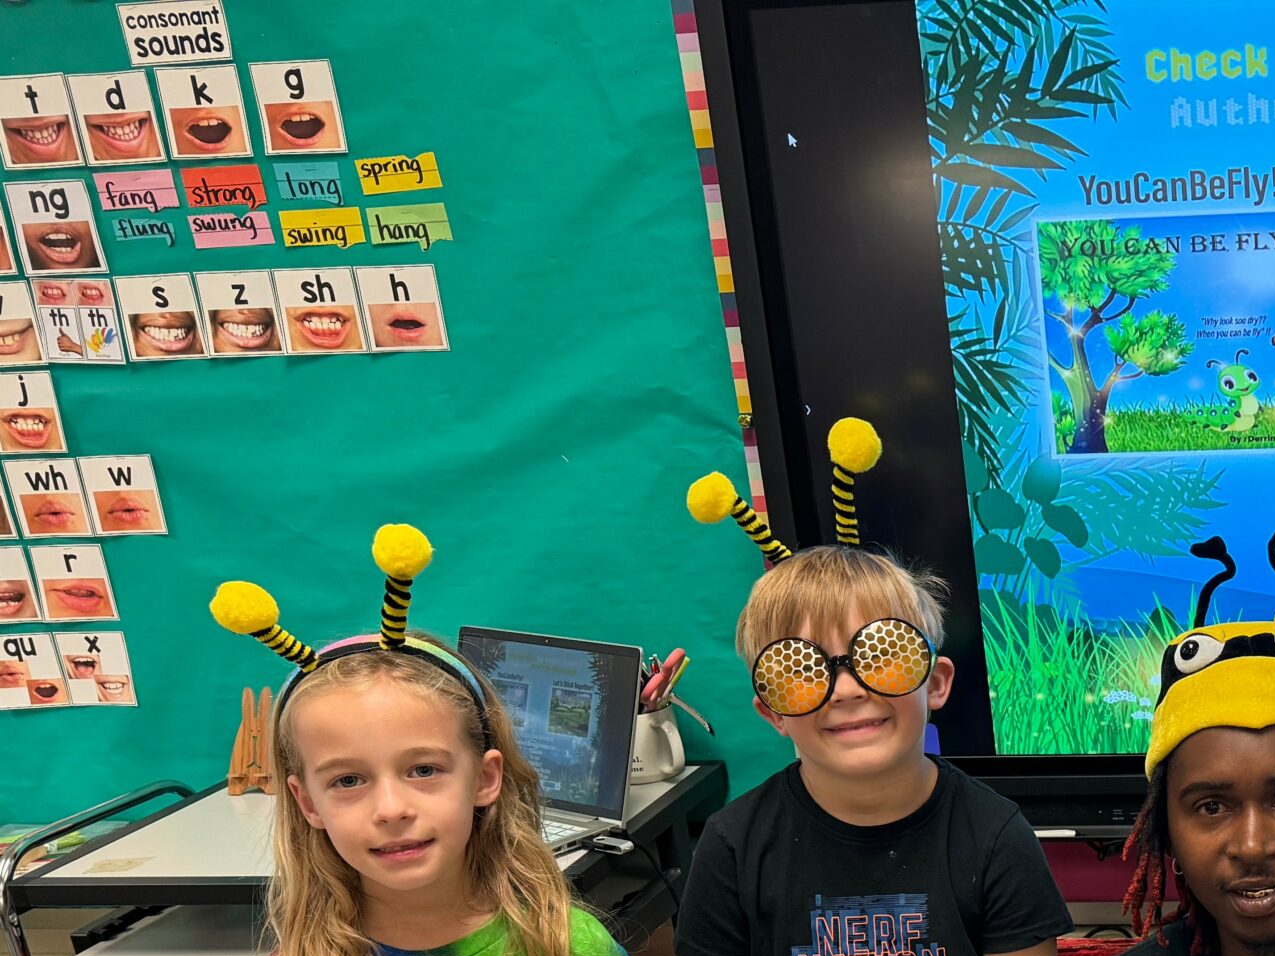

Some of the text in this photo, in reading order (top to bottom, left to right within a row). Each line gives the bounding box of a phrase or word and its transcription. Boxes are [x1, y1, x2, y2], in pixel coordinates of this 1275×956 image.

[125, 8, 220, 30] consonant
[134, 28, 225, 58] sounds
[1145, 43, 1268, 83] Check
[105, 79, 125, 110] d
[190, 75, 213, 105] k
[284, 68, 305, 99] g
[25, 84, 39, 114] t
[360, 155, 424, 185] spring
[105, 181, 155, 213] fang
[191, 178, 256, 210] strong
[285, 172, 341, 206] long
[28, 188, 70, 220] ng
[117, 217, 175, 247] flung
[191, 212, 258, 240] swung
[287, 223, 347, 248] swing
[378, 215, 431, 251] hang
[1061, 237, 1115, 259] YOU
[1124, 236, 1180, 256] CAN
[1190, 234, 1228, 253] BE
[152, 283, 170, 309] s
[231, 283, 249, 305] z
[301, 275, 336, 304] sh
[389, 274, 411, 302] h
[49, 308, 70, 327] th
[88, 309, 108, 328] th
[17, 374, 29, 408] j
[24, 464, 69, 492] wh
[107, 465, 132, 487] w
[62, 553, 78, 573] r
[3, 637, 38, 662] qu
[83, 635, 102, 654] x
